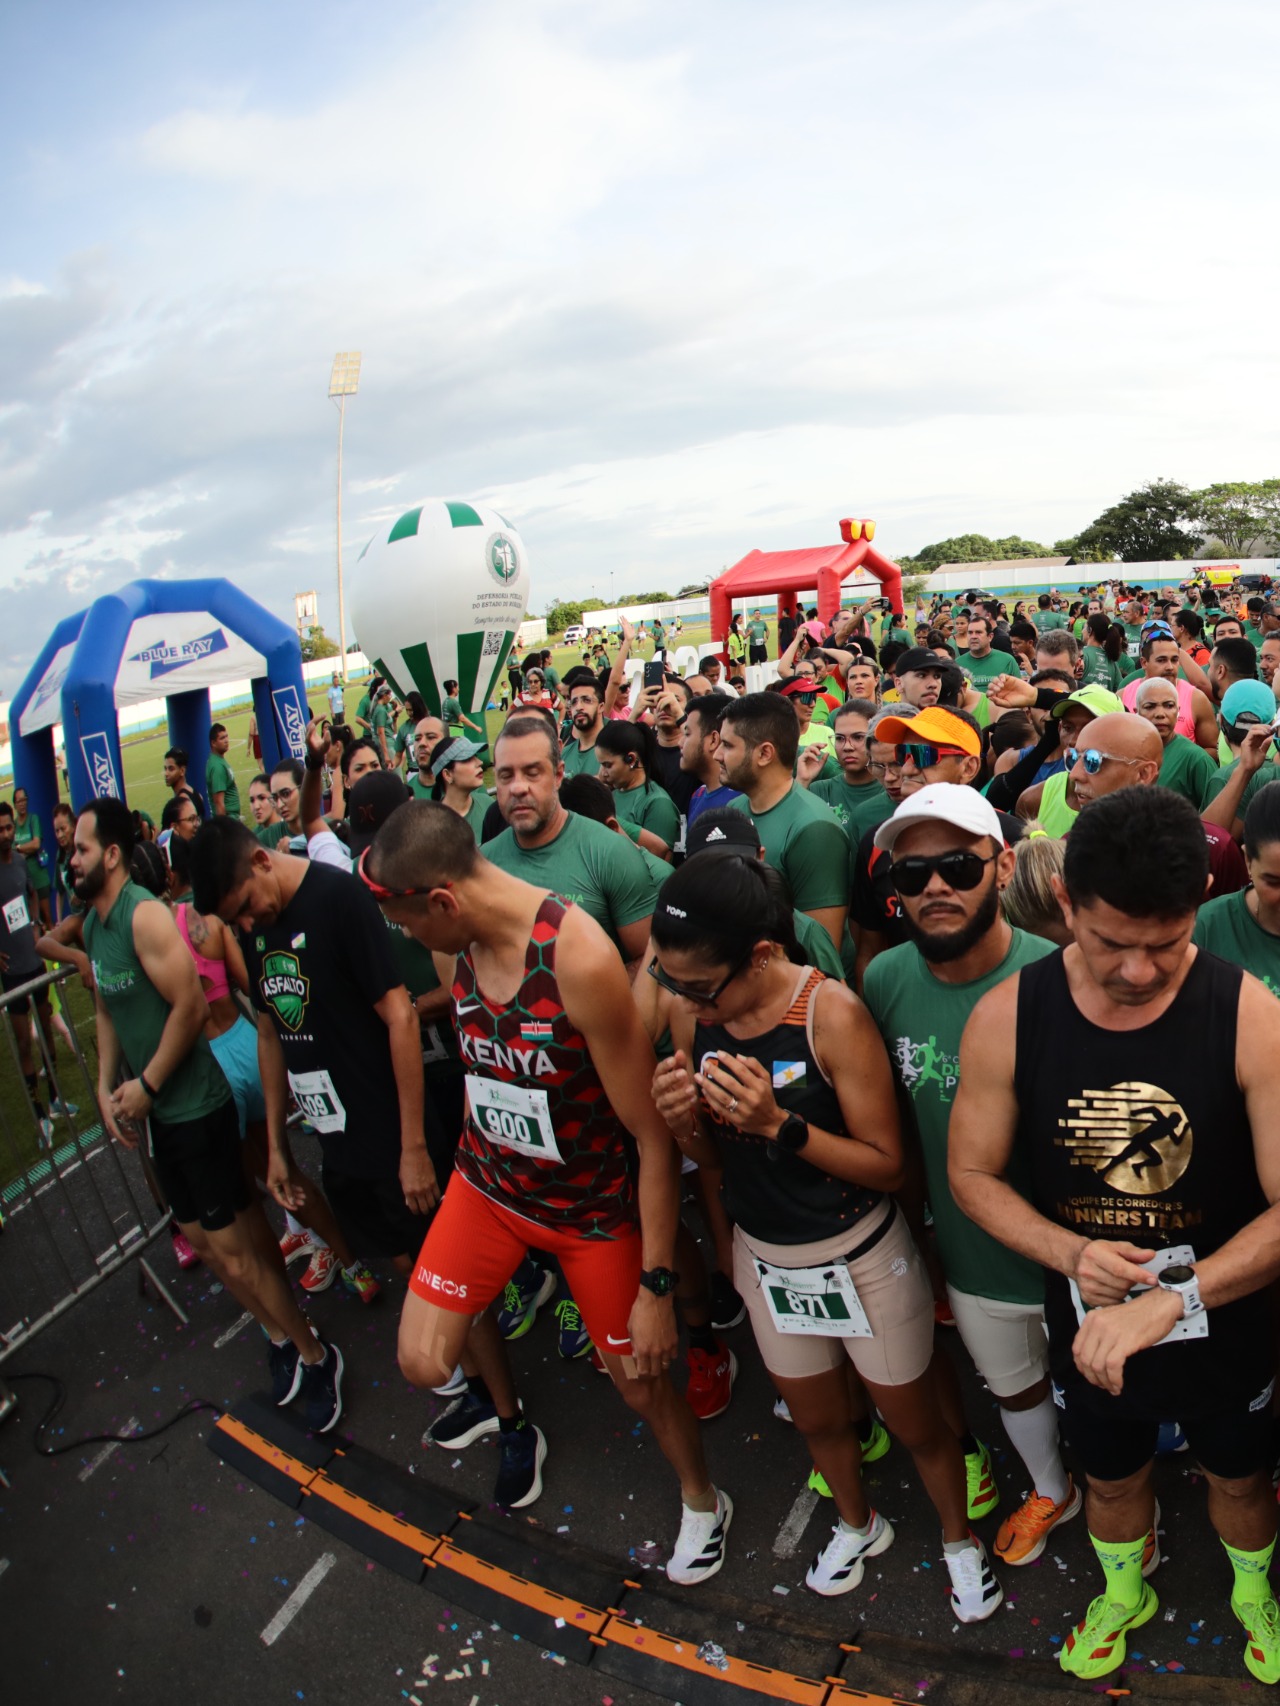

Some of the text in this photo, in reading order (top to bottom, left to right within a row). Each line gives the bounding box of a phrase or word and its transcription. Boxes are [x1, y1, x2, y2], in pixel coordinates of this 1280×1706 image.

[141, 647, 178, 662] BLUE
[182, 638, 213, 656] RAY
[666, 904, 687, 918] YOPP
[264, 976, 305, 997] ASFALTO
[459, 1030, 558, 1076] KENYA
[486, 1108, 531, 1143] 900
[1101, 1197, 1114, 1207] DE
[417, 1266, 468, 1298] INEOS
[785, 1289, 831, 1319] 871
